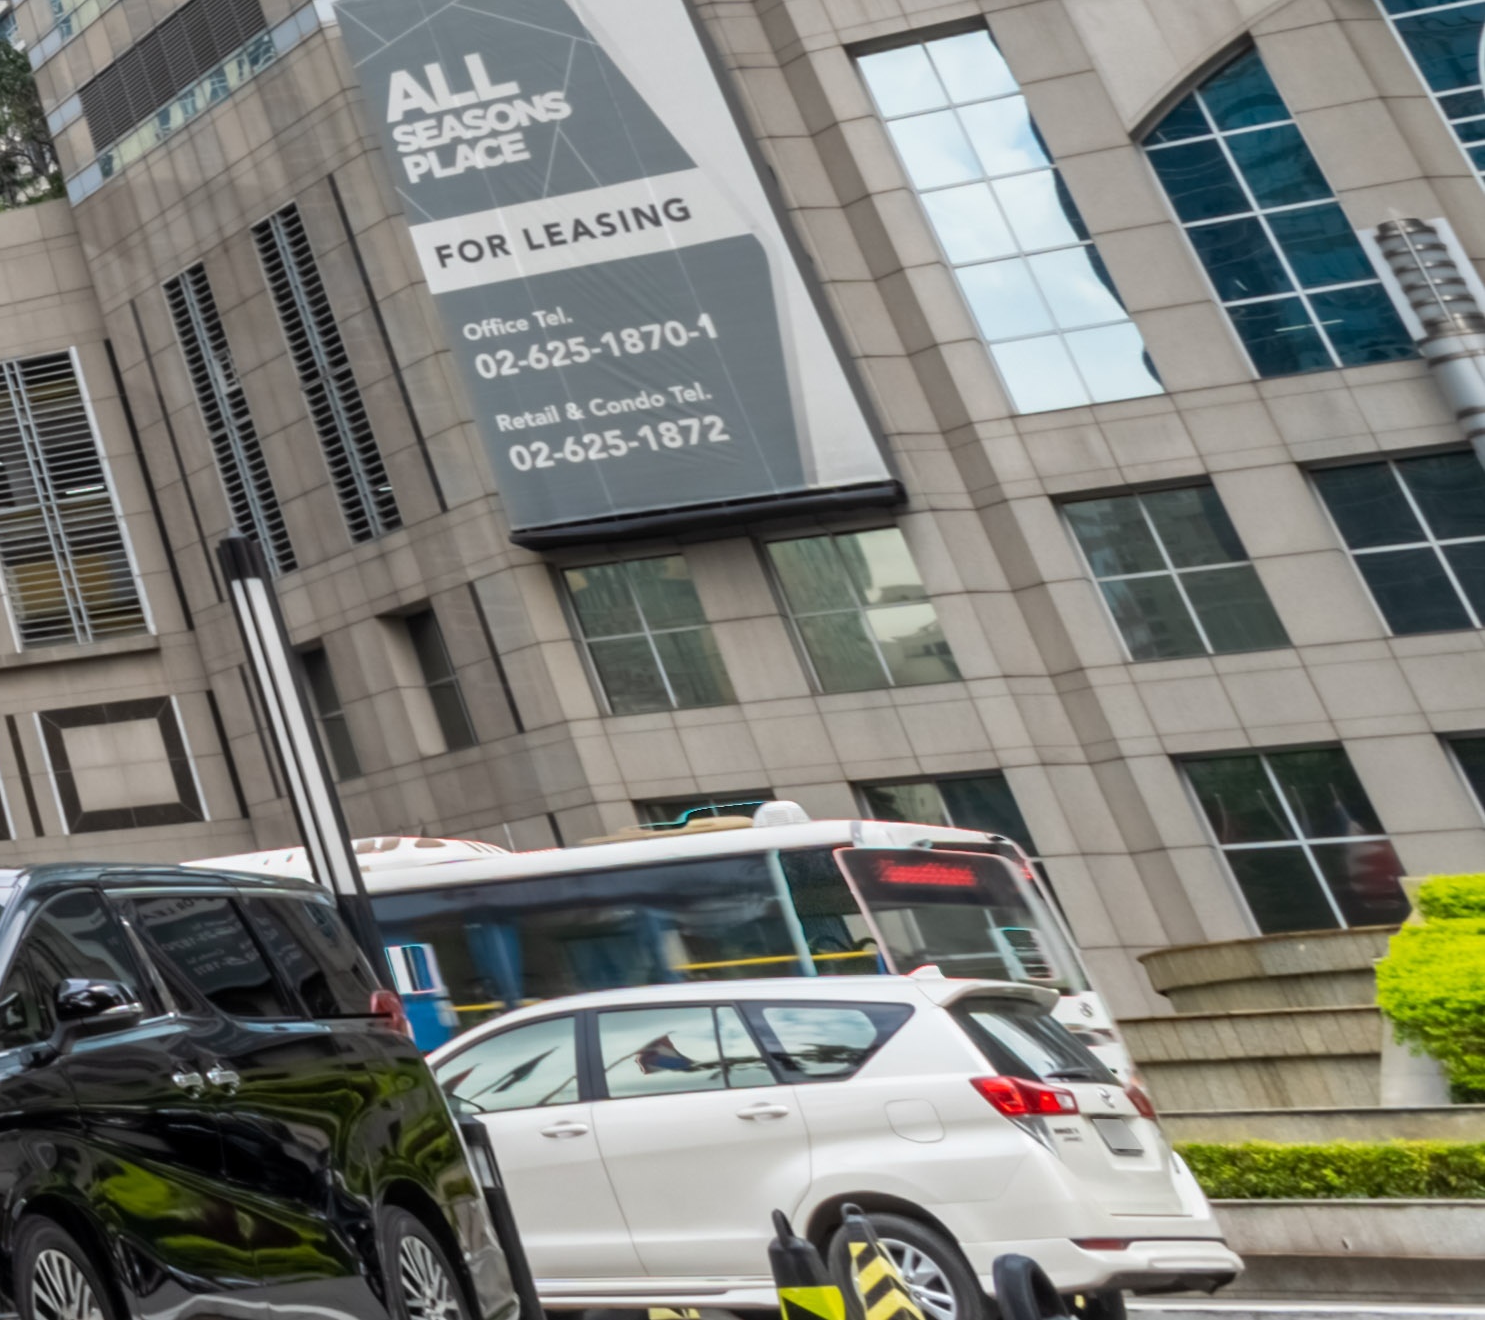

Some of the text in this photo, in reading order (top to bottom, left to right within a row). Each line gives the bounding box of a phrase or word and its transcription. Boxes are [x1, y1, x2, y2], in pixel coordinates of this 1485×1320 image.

[386, 52, 521, 123] ALL
[392, 90, 573, 153] SEASONS
[402, 131, 531, 184] PLACE
[434, 197, 691, 269] FOR LEASING
[462, 306, 573, 341] Office Tel.
[474, 312, 718, 379] 02-625-1870-1
[495, 382, 712, 432] Retail & Condo Tel.
[508, 415, 731, 471] 02-625-1872
